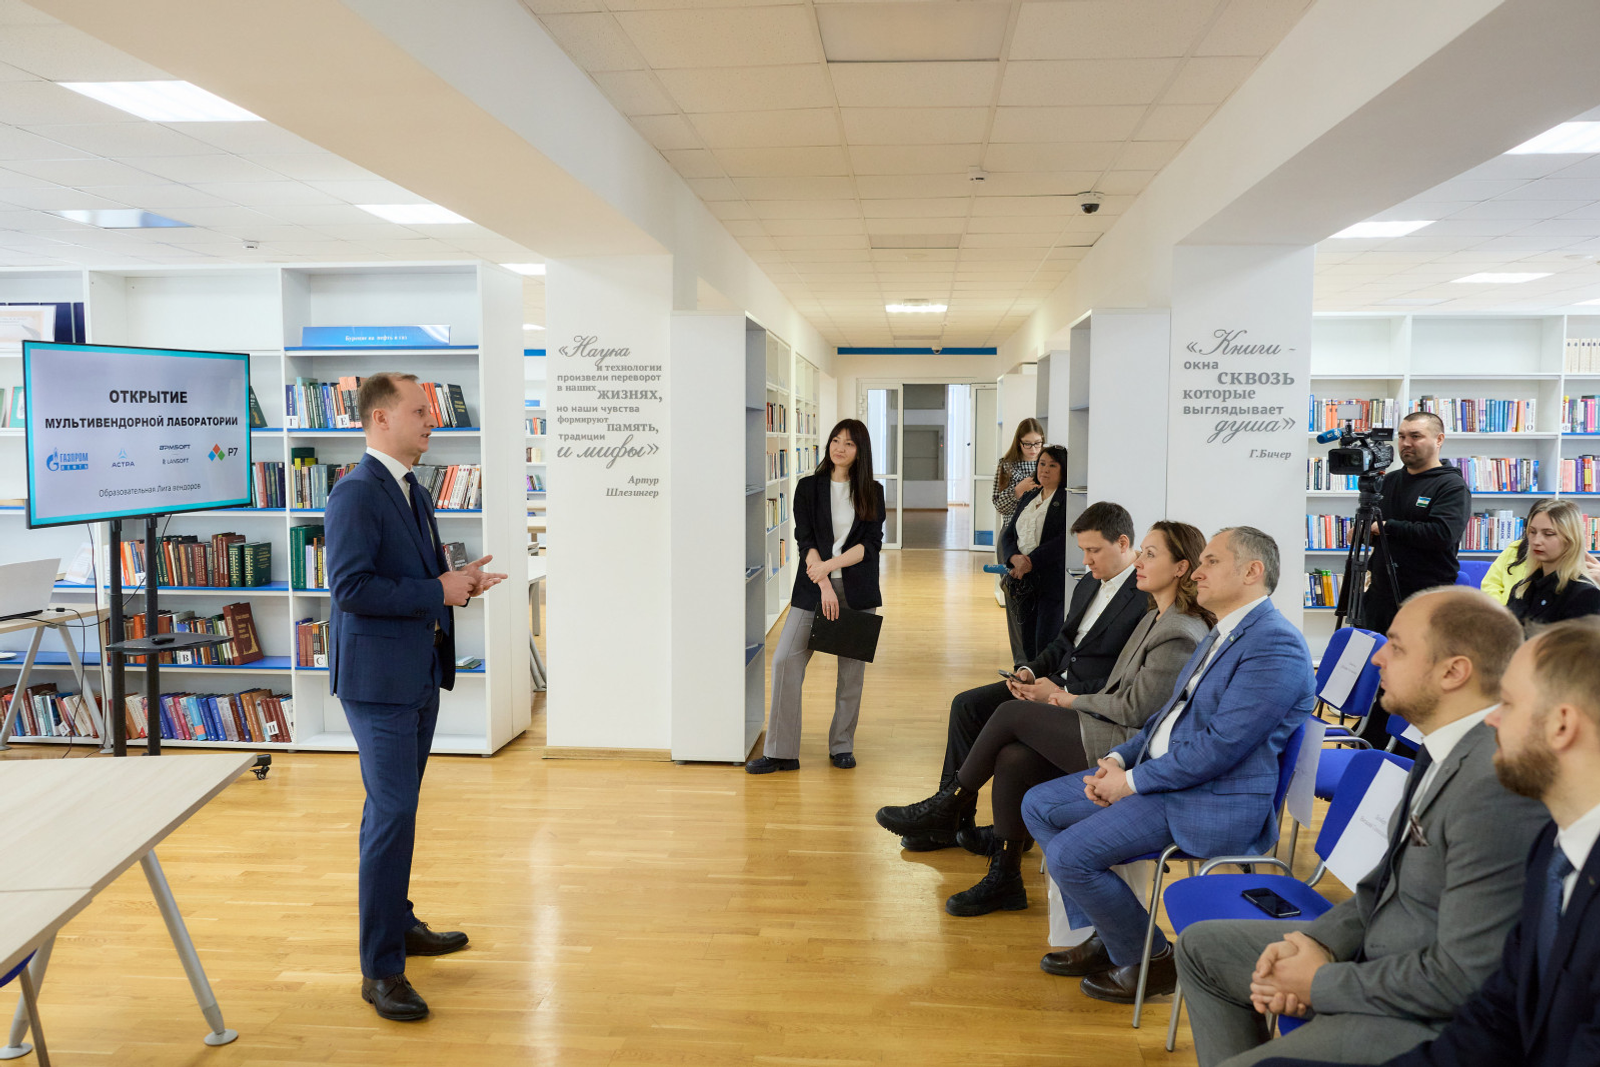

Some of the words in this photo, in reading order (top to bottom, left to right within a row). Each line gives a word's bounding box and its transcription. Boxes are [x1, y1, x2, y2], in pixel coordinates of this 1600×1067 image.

[1186, 329, 1281, 356] «Книги
[558, 335, 631, 367] «Наука
[604, 364, 662, 372] технологии
[1184, 361, 1219, 370] окна
[557, 374, 609, 383] произвели
[611, 374, 661, 383] переворот
[1217, 372, 1295, 385] сквозь
[109, 390, 188, 404] ОТКРЫТИЕ
[597, 390, 663, 402] жизнях,
[1183, 388, 1256, 402] которые
[601, 406, 640, 414] чувства
[1183, 405, 1284, 416] выглядывает
[45, 415, 164, 430] МУЛЬТИВЕНДОРНОЙ
[166, 416, 238, 428] ЛАБОРАТОРИИ
[557, 415, 609, 425] формируют
[607, 423, 659, 435] память,
[1207, 417, 1296, 444] душа»
[558, 433, 606, 441] традиции
[59, 452, 89, 462] ГАЗПРОМ
[557, 446, 573, 458] и
[576, 434, 659, 469] мифы»
[1249, 449, 1292, 460] Г.Бичер
[627, 475, 659, 486] Артур
[99, 485, 156, 498] Образовательная
[172, 482, 202, 493] вендоров
[606, 488, 659, 498] Шлезингер
